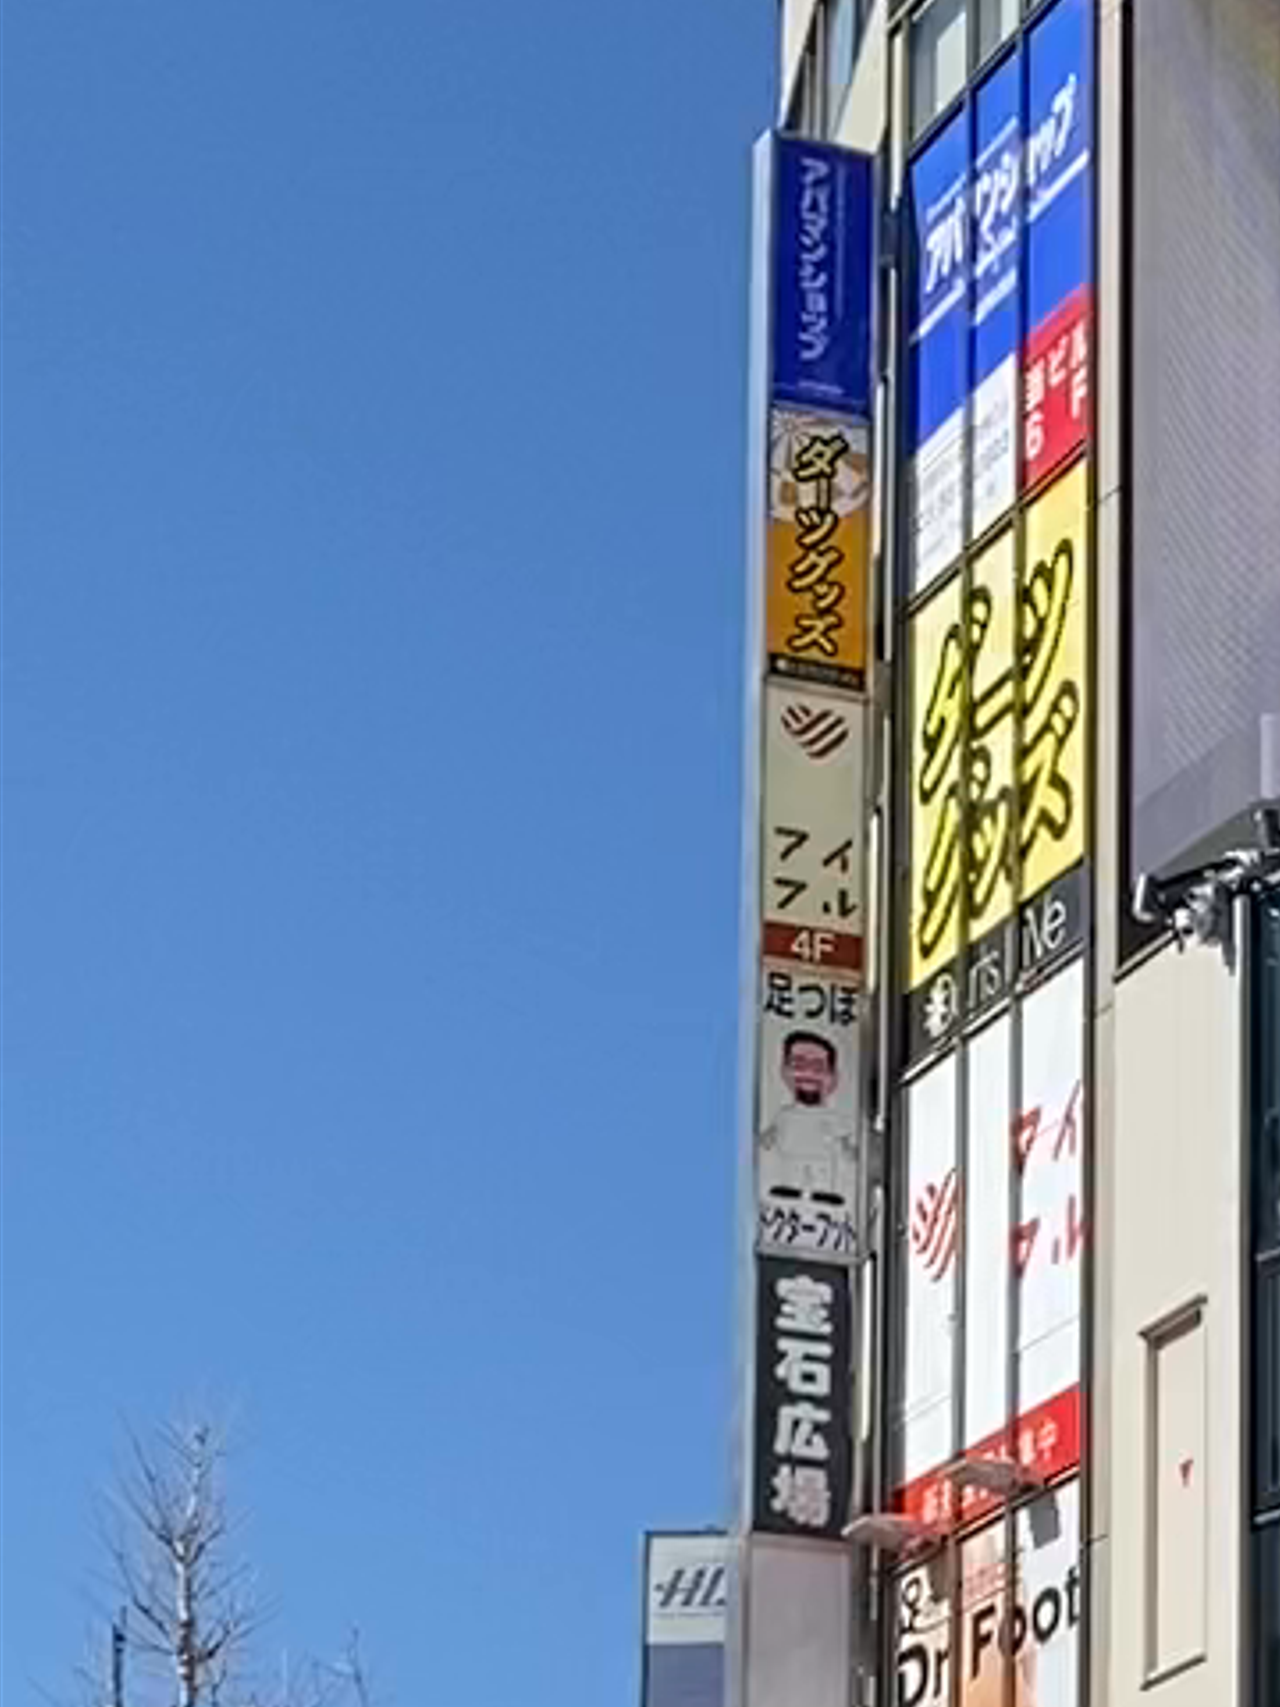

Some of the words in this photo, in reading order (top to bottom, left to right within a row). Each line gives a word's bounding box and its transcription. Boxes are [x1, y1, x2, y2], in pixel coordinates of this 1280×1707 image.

[791, 928, 836, 965] 4F
[763, 971, 857, 1027] 足つぼ
[772, 1274, 833, 1529] 宝石広場
[970, 1569, 1080, 1681] Foot
